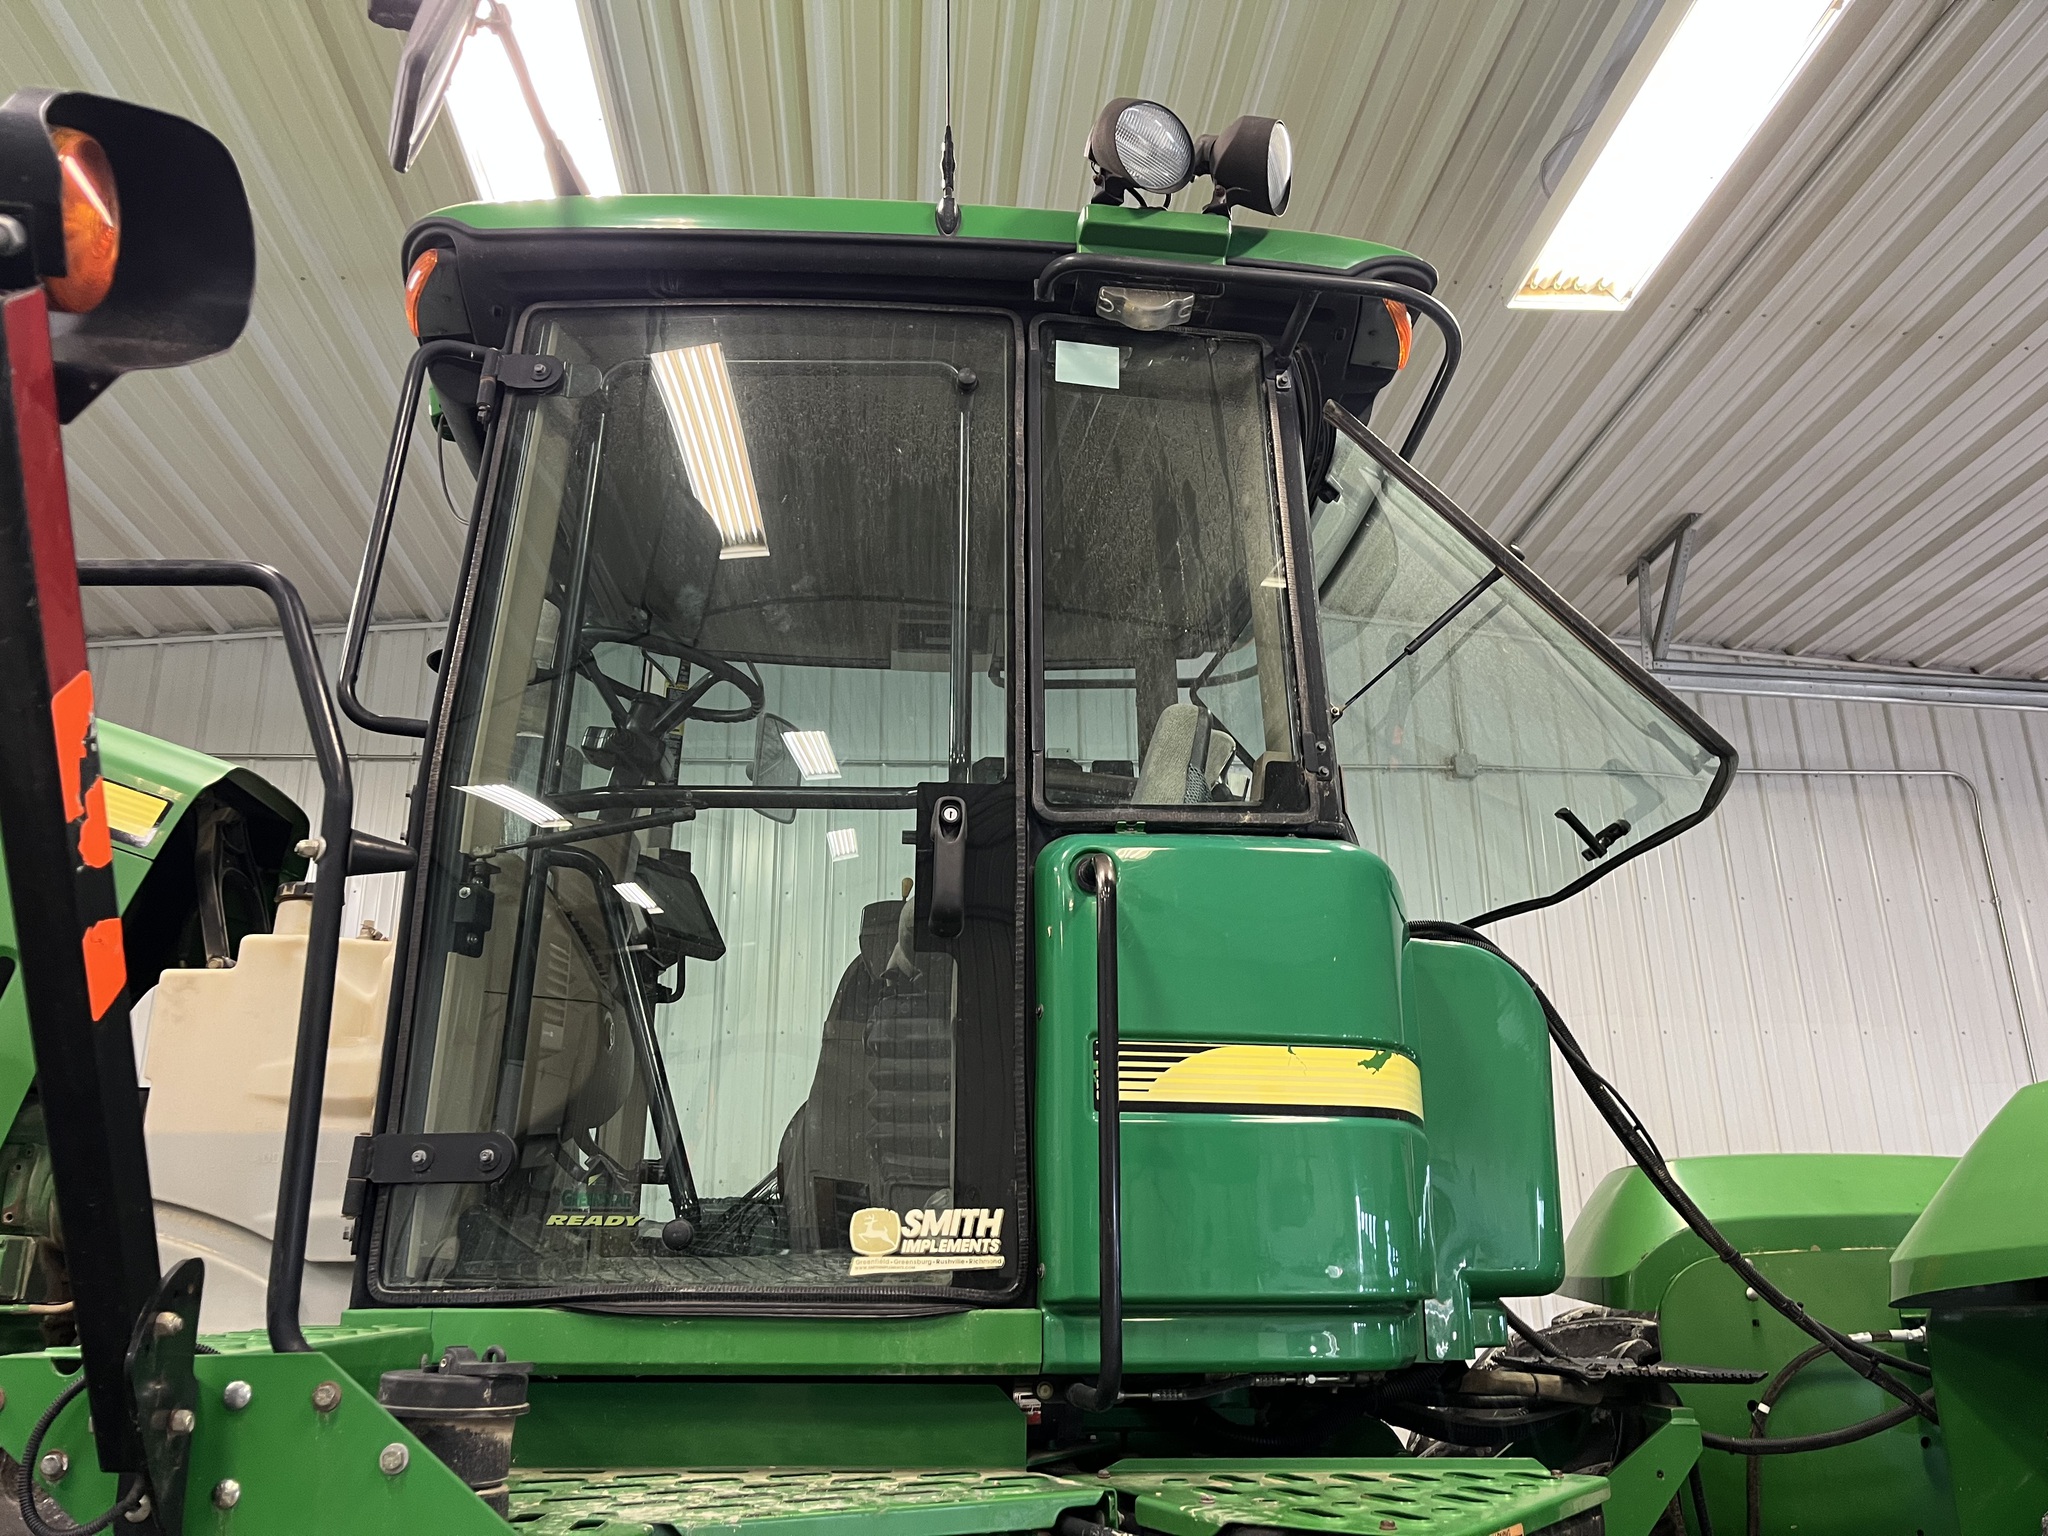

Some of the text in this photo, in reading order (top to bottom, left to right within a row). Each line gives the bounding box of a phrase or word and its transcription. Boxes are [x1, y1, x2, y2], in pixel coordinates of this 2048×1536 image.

[545, 1214, 643, 1228] READY
[901, 1208, 1004, 1238] SMITH
[901, 1238, 1002, 1254] IMPLEMENTS
[894, 1258, 932, 1266] Greensburg
